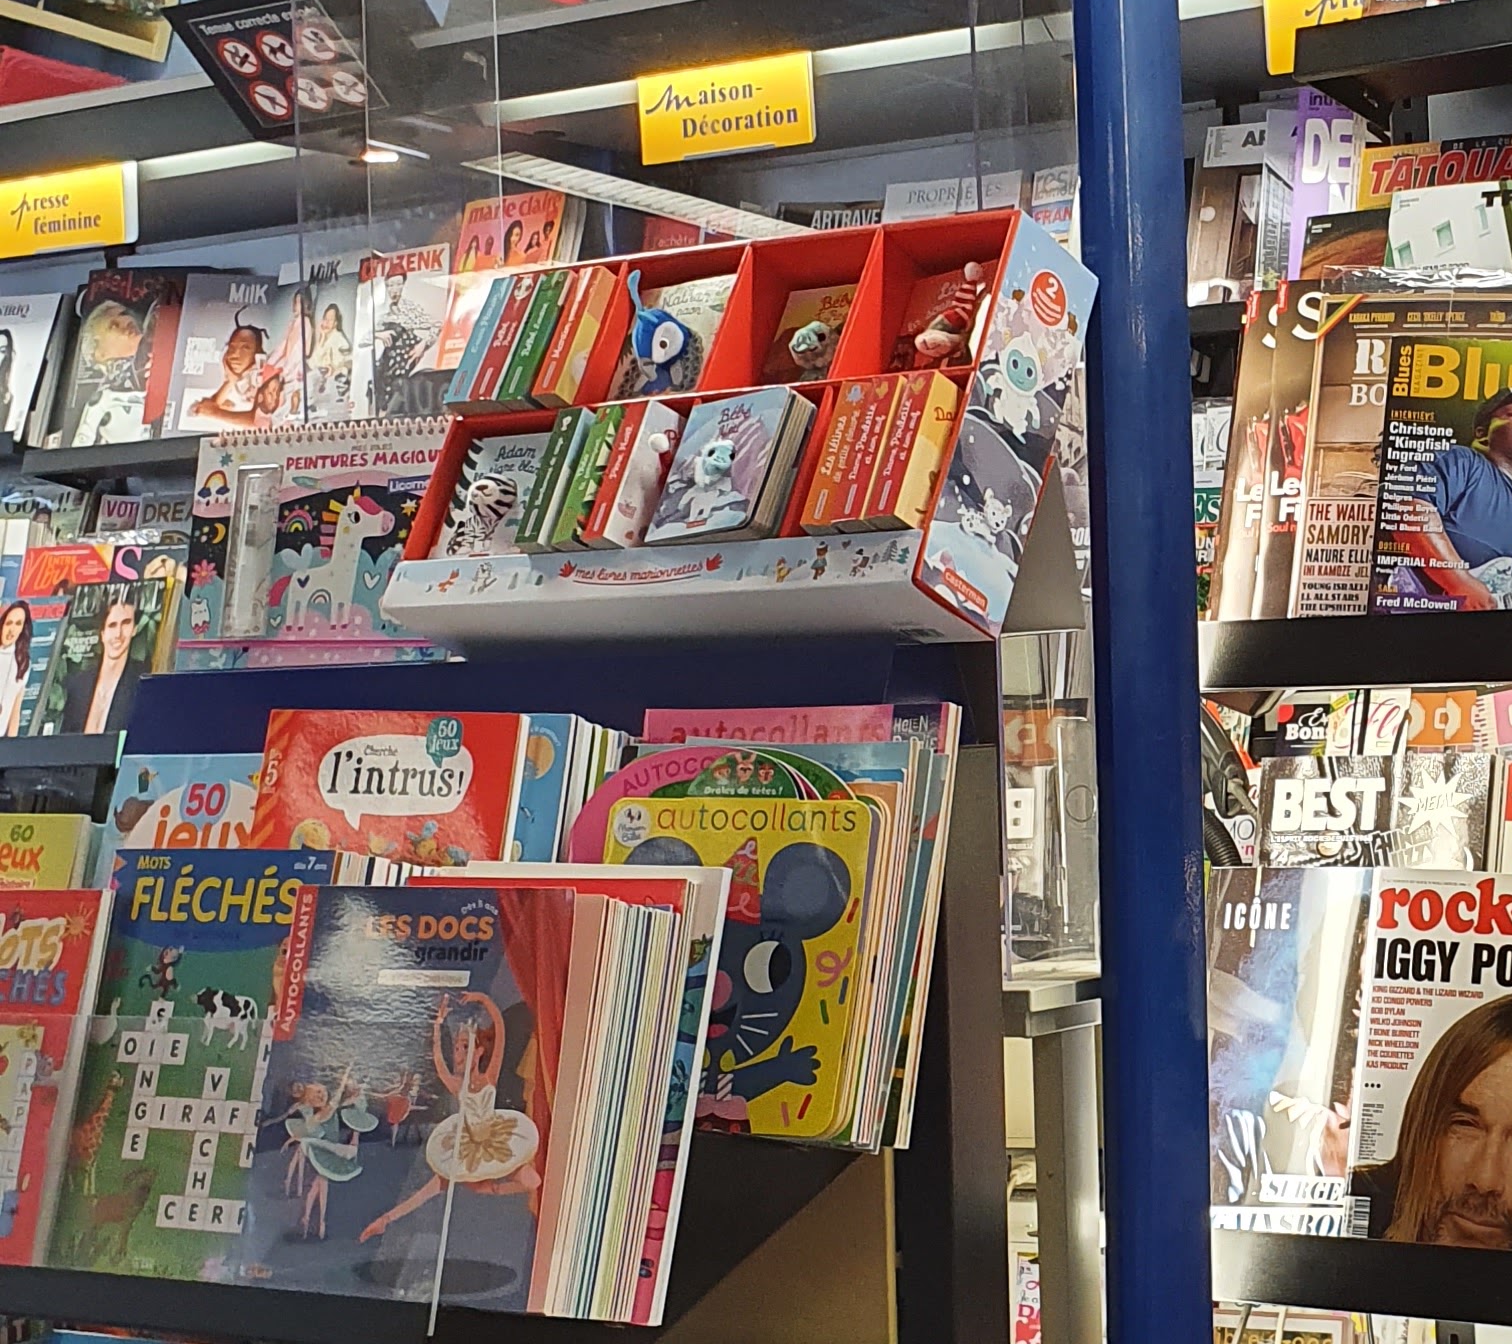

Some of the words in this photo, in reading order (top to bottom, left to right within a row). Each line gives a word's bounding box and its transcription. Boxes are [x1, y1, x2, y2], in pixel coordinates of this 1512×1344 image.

[645, 79, 764, 115] Maison-
[682, 104, 799, 141] Décoration
[33, 212, 101, 236] féminine
[1393, 346, 1412, 399] Blues
[1389, 423, 1454, 438] Christone
[498, 445, 536, 462] Adam
[944, 567, 988, 609] casterman
[1376, 596, 1398, 608] Fred
[1401, 597, 1457, 611] McDowell
[436, 720, 458, 737] 60
[185, 783, 226, 816] 50
[1270, 776, 1386, 833] BEST
[657, 804, 857, 833] autocollants
[280, 893, 313, 1033] AUTOCOLLANTS
[1374, 937, 1459, 985] IGGY
